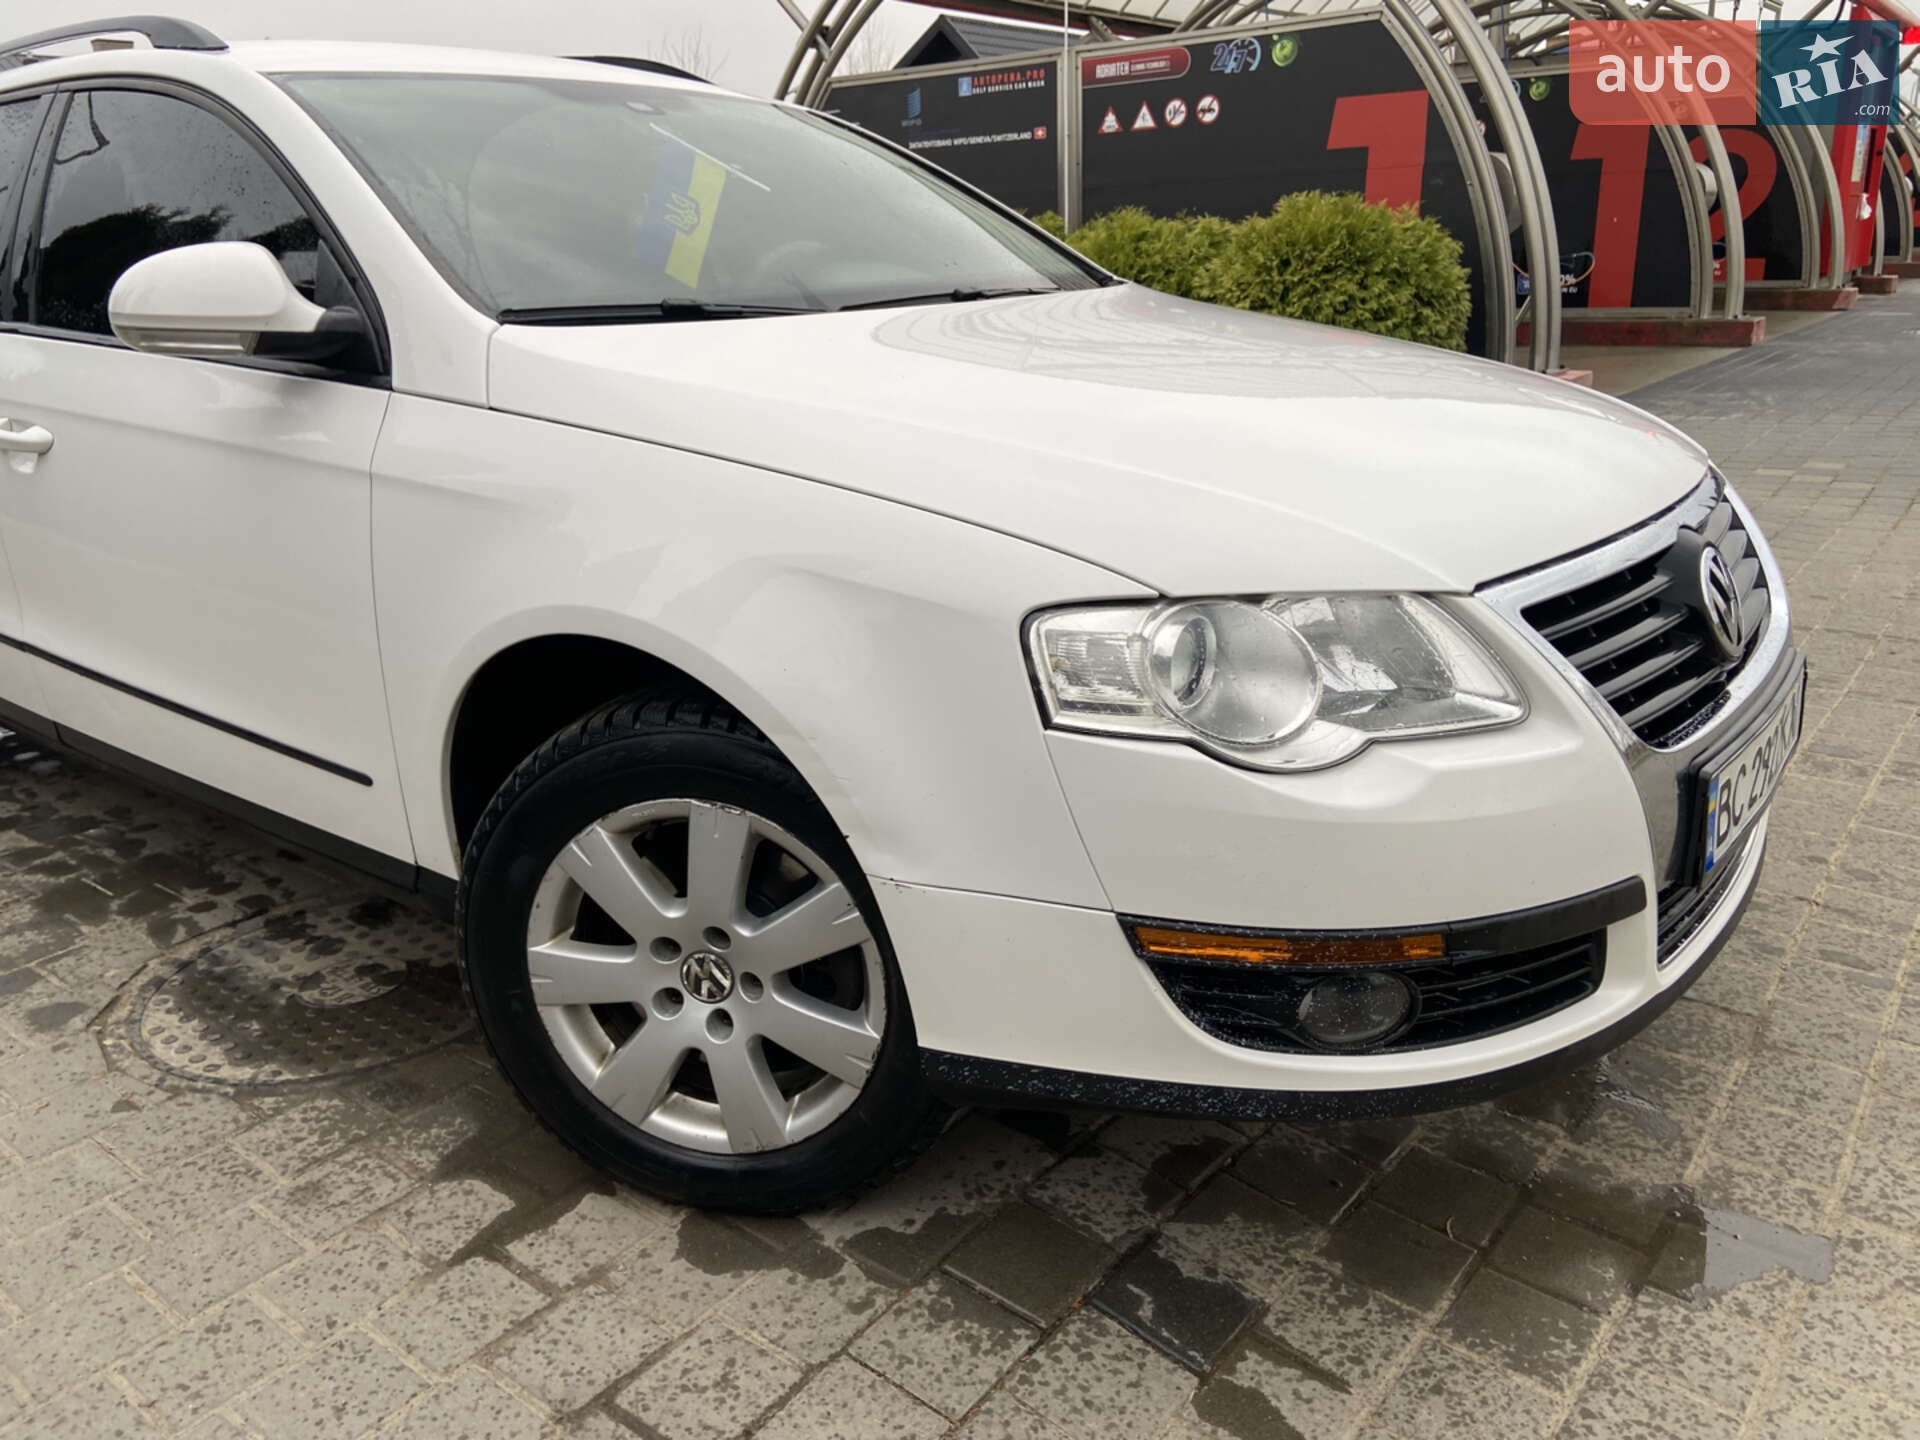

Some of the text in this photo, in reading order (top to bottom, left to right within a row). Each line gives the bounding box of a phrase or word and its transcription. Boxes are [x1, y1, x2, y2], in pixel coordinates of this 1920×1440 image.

[1326, 89, 1430, 218] 1
[1569, 118, 1650, 309] 1
[1716, 763, 1747, 848] BC
